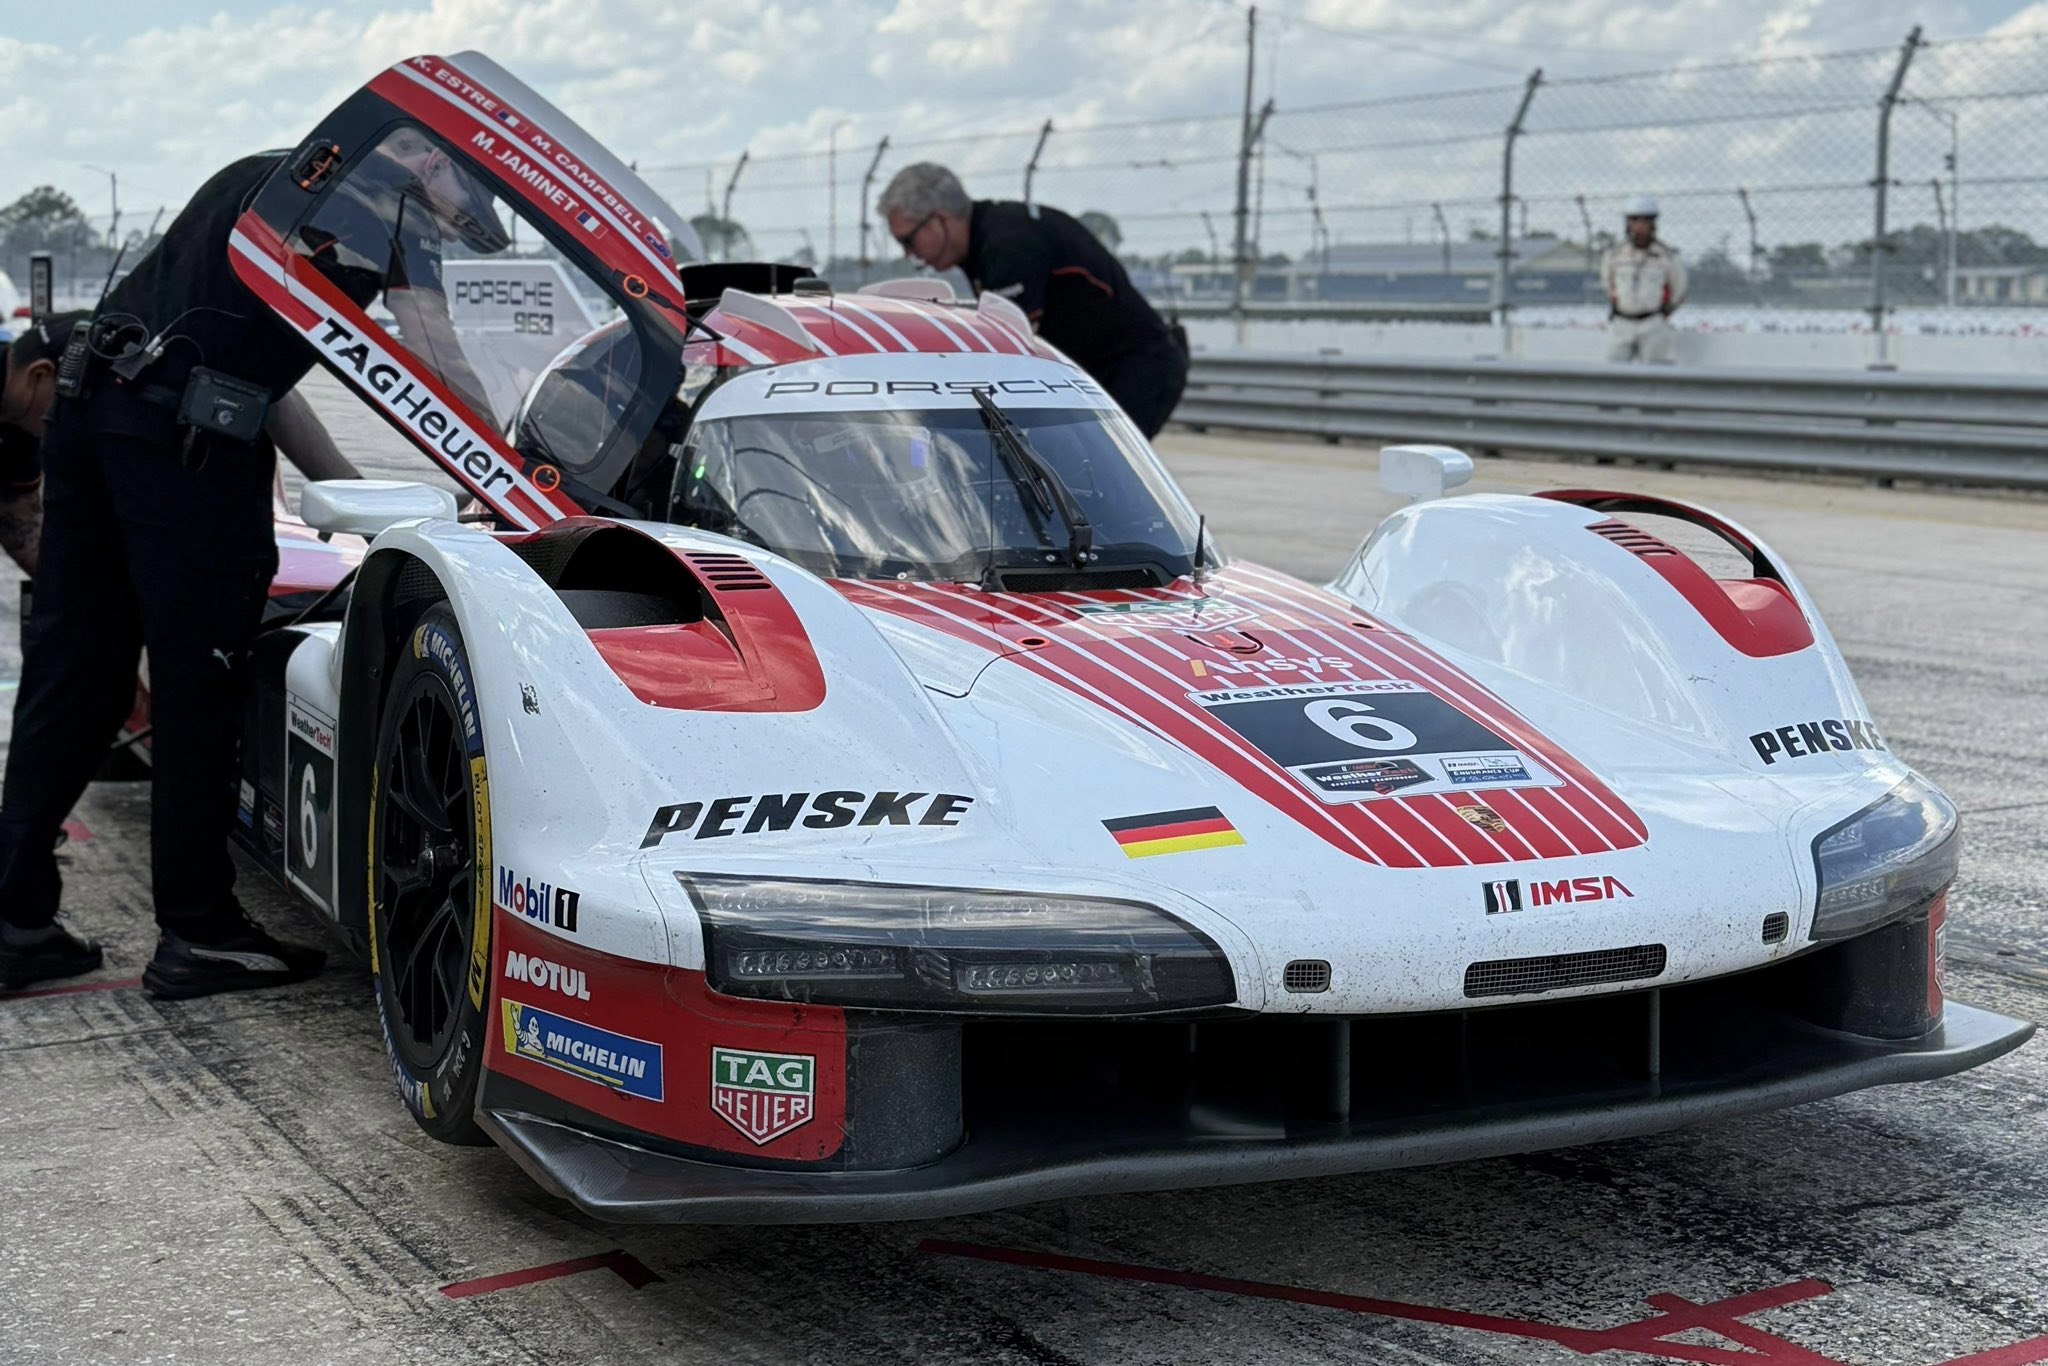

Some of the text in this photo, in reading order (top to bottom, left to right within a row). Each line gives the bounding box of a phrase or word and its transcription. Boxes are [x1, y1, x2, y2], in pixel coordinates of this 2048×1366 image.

[412, 55, 643, 233] K. ESTRE M. CAMPBELL
[471, 130, 579, 213] M. JAMINET
[455, 279, 553, 307] PORSCHE
[514, 311, 554, 336] 963
[764, 379, 1103, 399] PORSCHE
[430, 631, 477, 739] MICHELIN
[1190, 655, 1354, 678] Ansys
[1200, 681, 1416, 702] WeatherTech
[290, 710, 332, 752] WeatherTech
[1303, 699, 1418, 750] 6
[1748, 718, 1890, 766] PENSKE
[301, 762, 318, 870] 6
[473, 772, 484, 828] PILOT
[637, 790, 976, 850] PENSKE
[499, 865, 552, 925] Mobil
[1529, 875, 1636, 907] IMSA
[504, 950, 592, 1002] MOTUL
[545, 1031, 647, 1080] MICHELIN
[720, 1055, 804, 1089] TAG
[718, 1092, 807, 1137] HEUER
